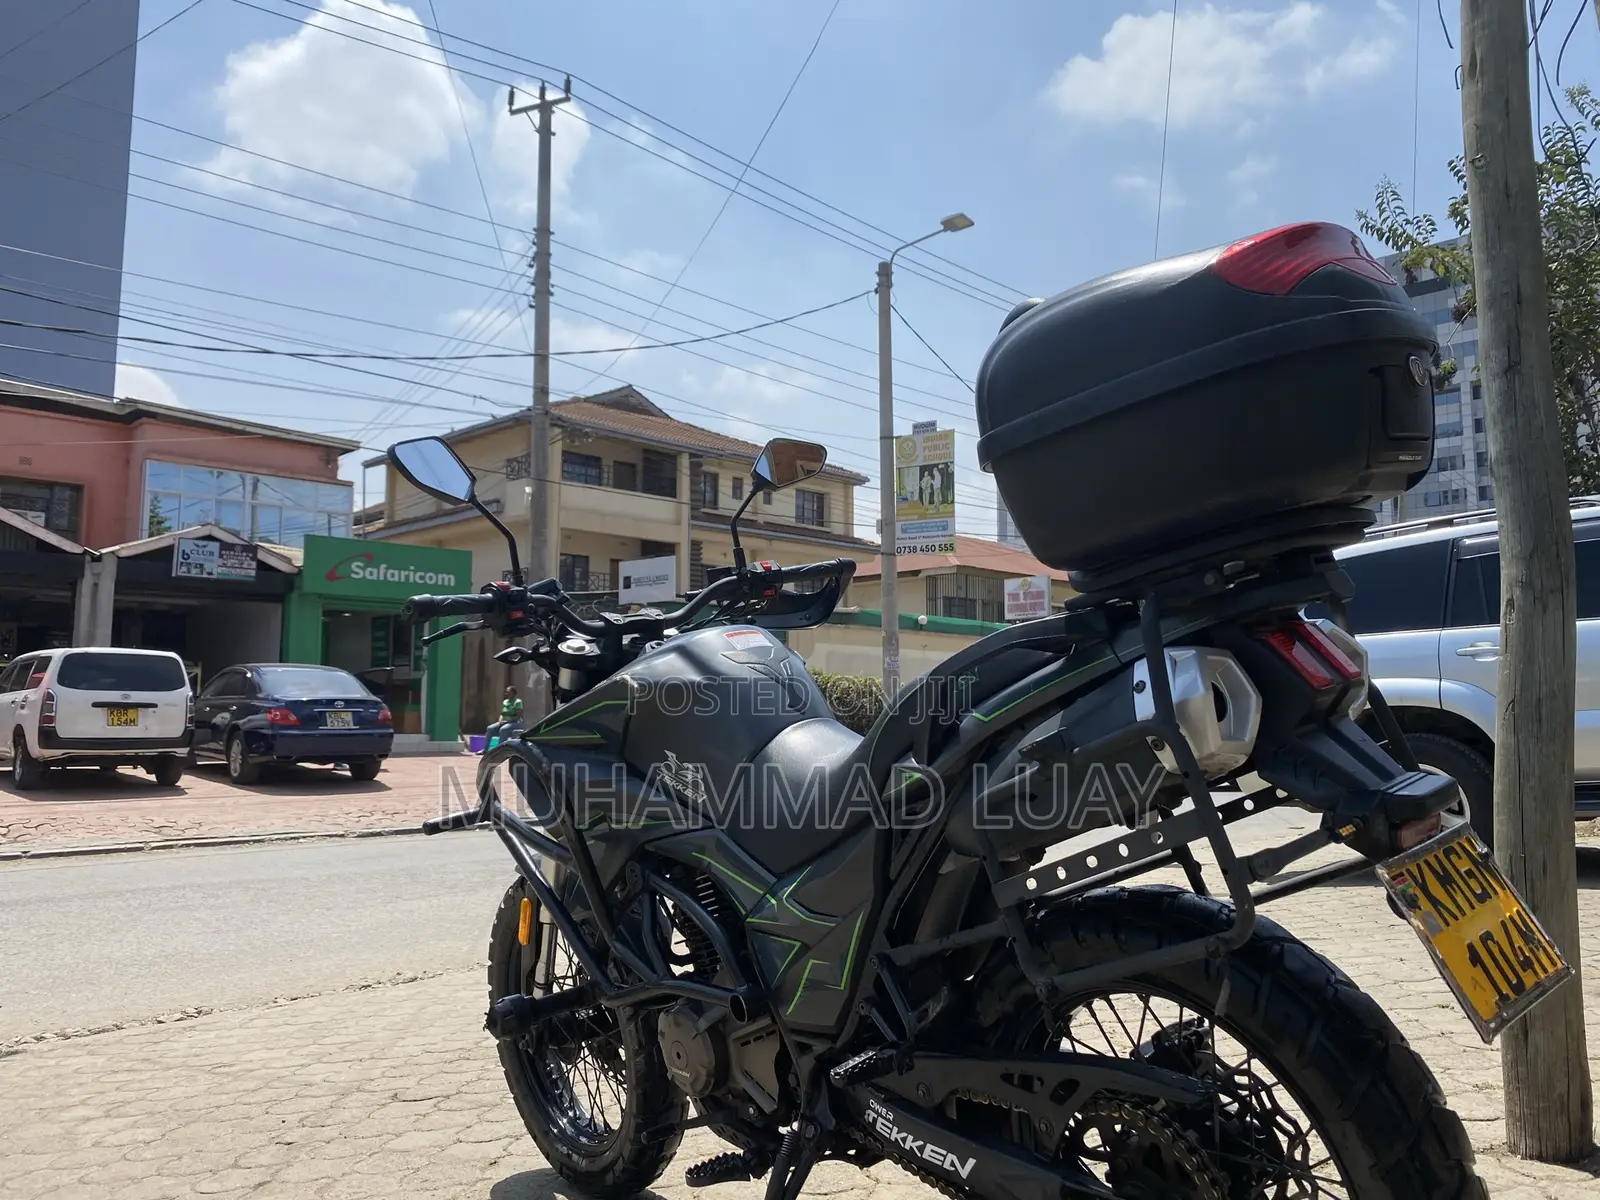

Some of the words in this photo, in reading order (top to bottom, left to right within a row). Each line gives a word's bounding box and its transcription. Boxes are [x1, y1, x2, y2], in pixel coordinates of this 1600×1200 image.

[190, 548, 215, 557] CLUB
[896, 545, 918, 554] 0738
[919, 544, 936, 553] 450
[938, 543, 955, 552] 555
[350, 561, 456, 586] Safaricom
[109, 709, 129, 718] KBR
[110, 717, 136, 726] 154M
[328, 712, 345, 720] KBL
[656, 769, 708, 804] TEKKEN
[1405, 836, 1507, 927] KMGN
[1466, 908, 1558, 1007] 104M
[864, 1109, 977, 1180] TEKKEN
